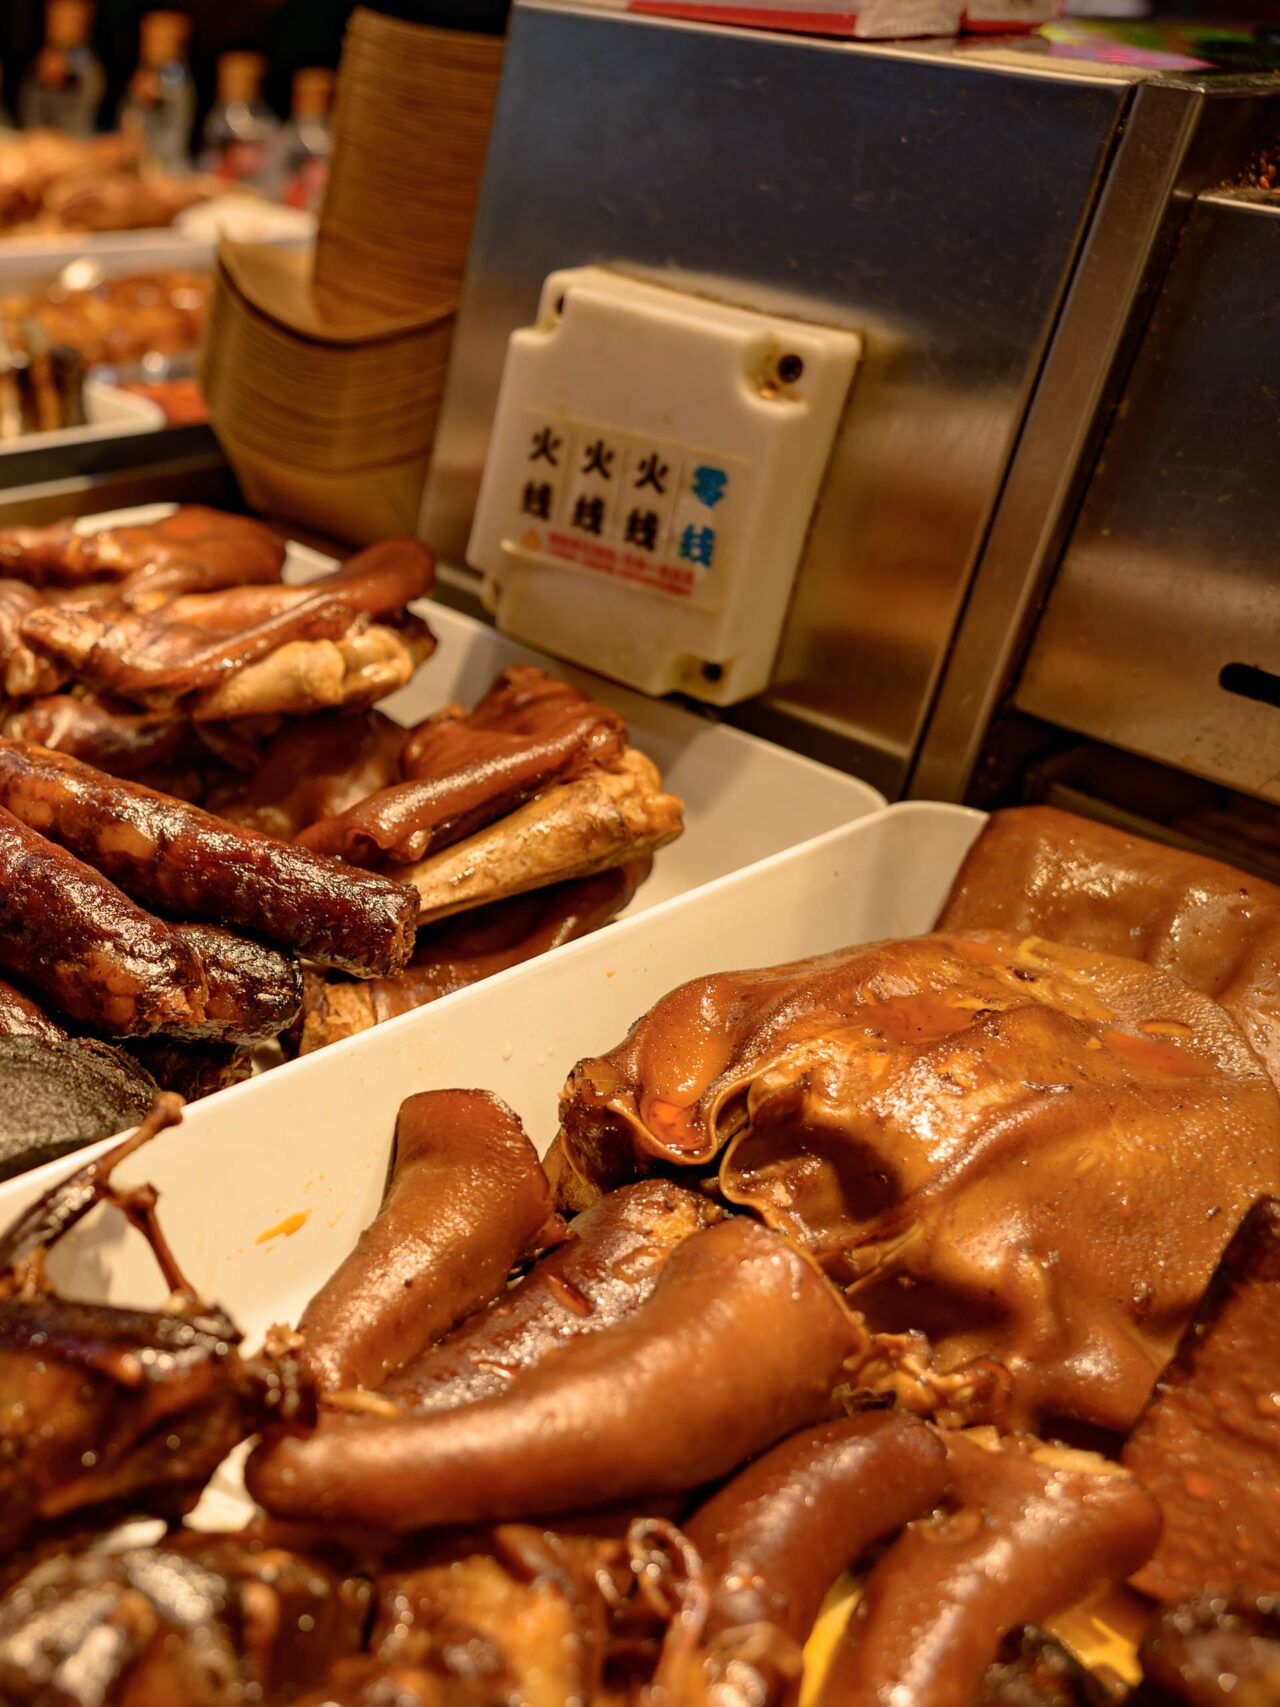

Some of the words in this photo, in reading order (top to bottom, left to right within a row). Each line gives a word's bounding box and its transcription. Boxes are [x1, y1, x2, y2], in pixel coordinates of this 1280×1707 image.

[522, 427, 560, 520] 火线
[572, 440, 613, 534] 火线
[624, 453, 668, 550] 火线
[679, 466, 727, 566] 零线
